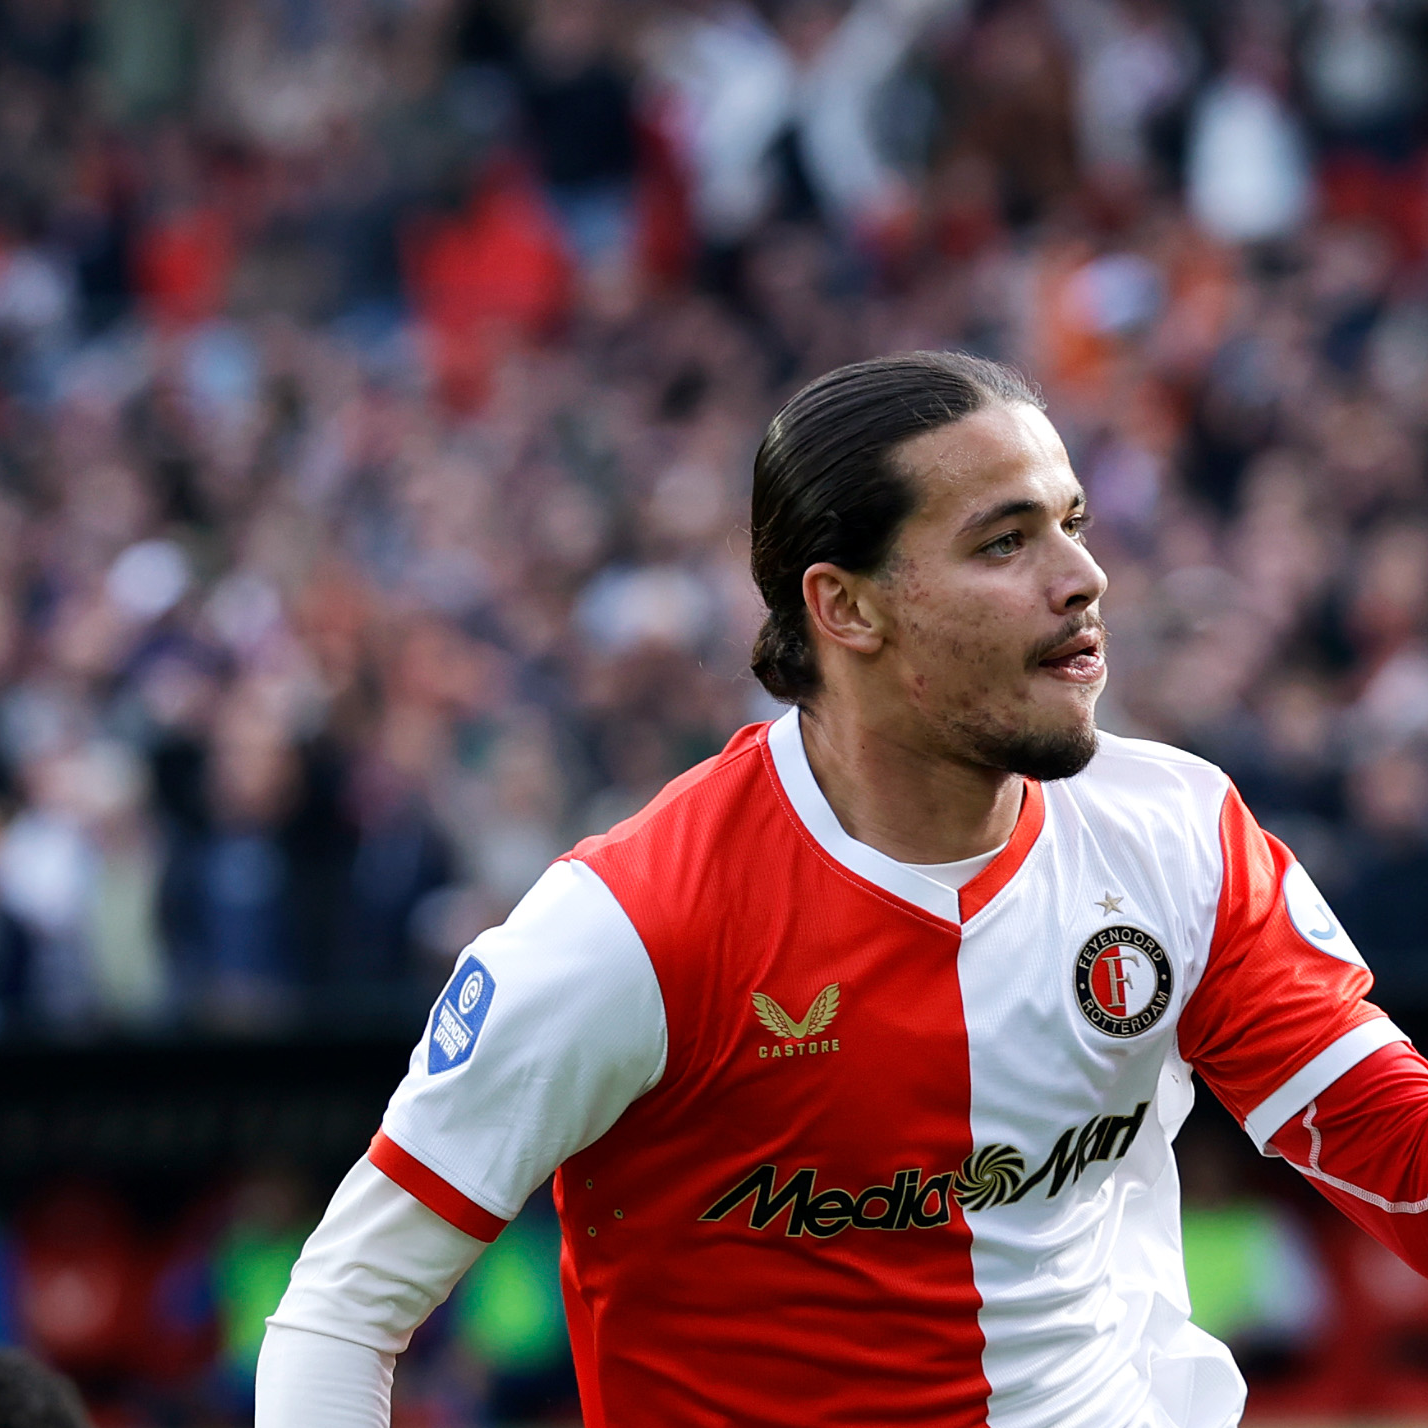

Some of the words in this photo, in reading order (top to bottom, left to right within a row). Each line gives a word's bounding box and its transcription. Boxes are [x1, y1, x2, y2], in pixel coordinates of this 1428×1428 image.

[1078, 928, 1164, 970] FEYENOORD
[1101, 954, 1140, 1008] F
[439, 1005, 470, 1051] VRIENDEN
[1081, 990, 1169, 1034] ROTTERDAM
[758, 1039, 840, 1059] CASTORE
[697, 1164, 955, 1239] Media
